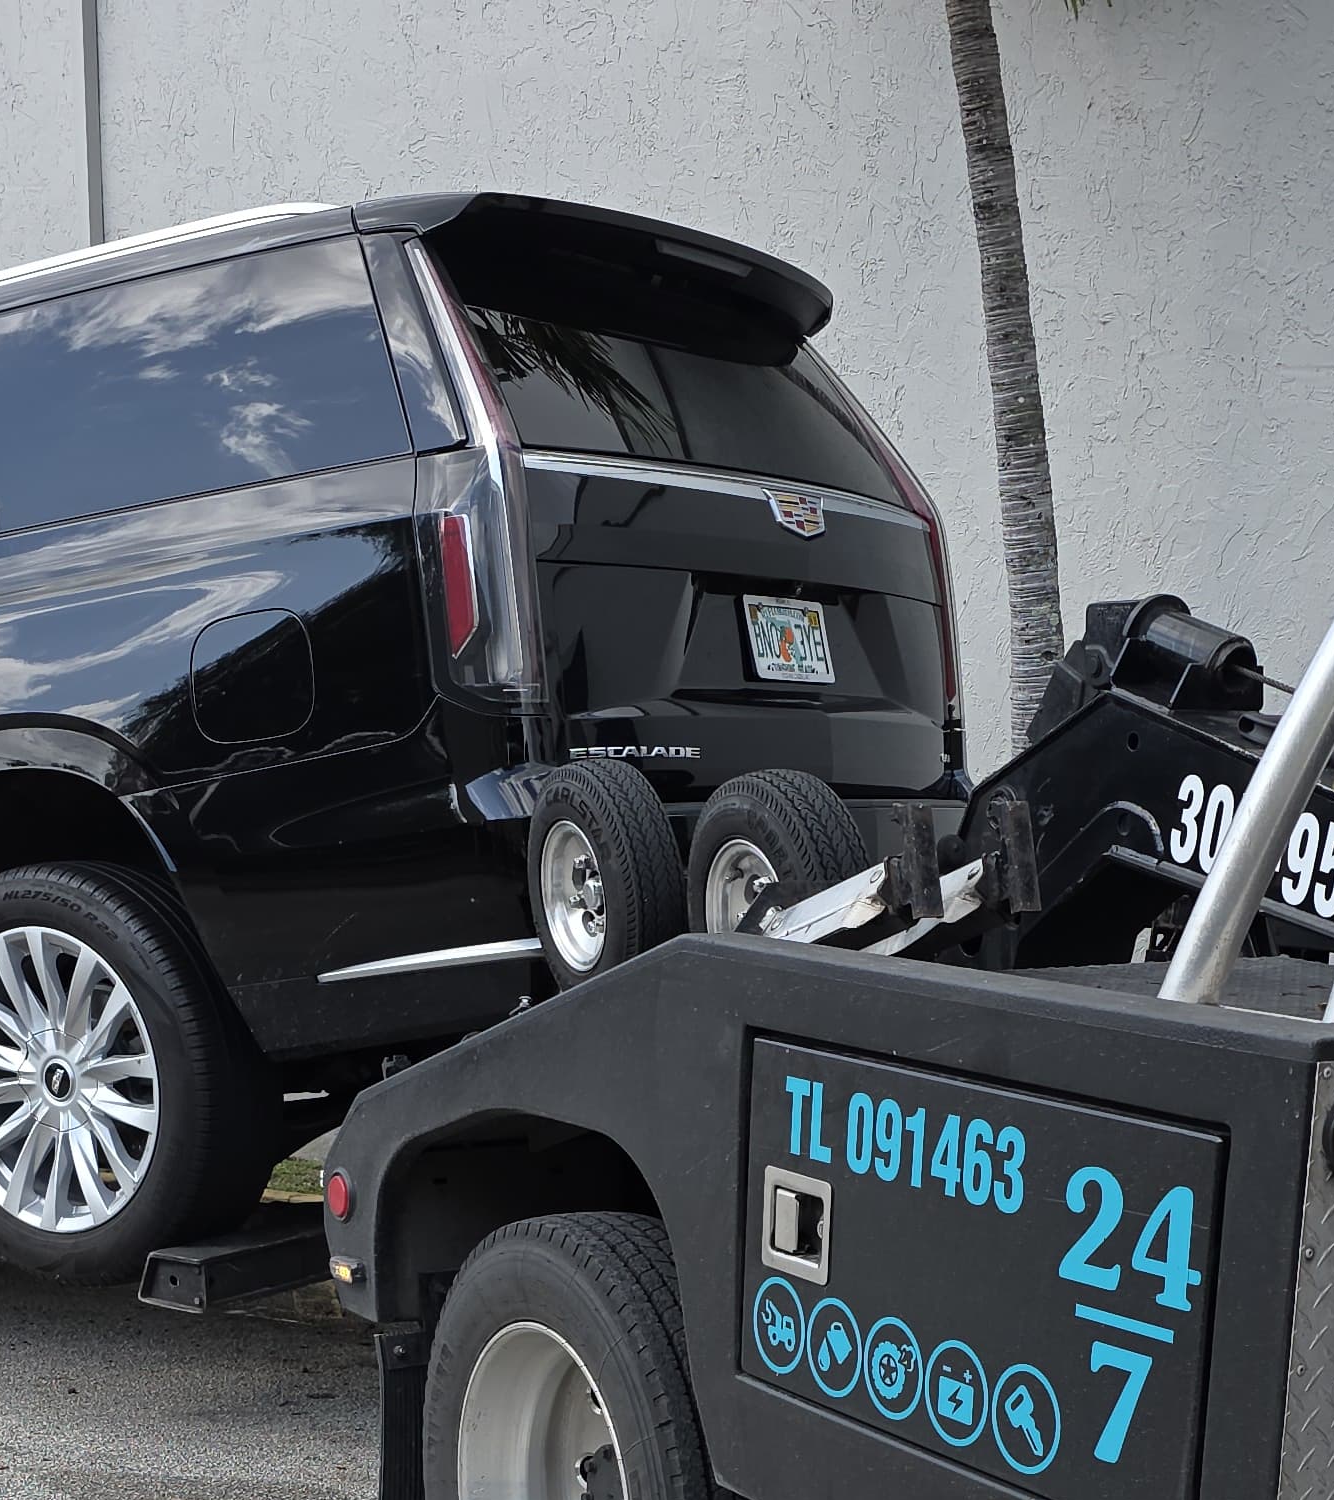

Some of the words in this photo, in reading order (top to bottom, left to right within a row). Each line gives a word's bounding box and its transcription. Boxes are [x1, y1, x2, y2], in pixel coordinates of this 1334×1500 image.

[569, 746, 701, 759] ESCALADE
[786, 1076, 832, 1164] TL
[847, 1093, 1026, 1214] 091463
[1058, 1166, 1202, 1312] 24
[1091, 1340, 1153, 1464] 7
